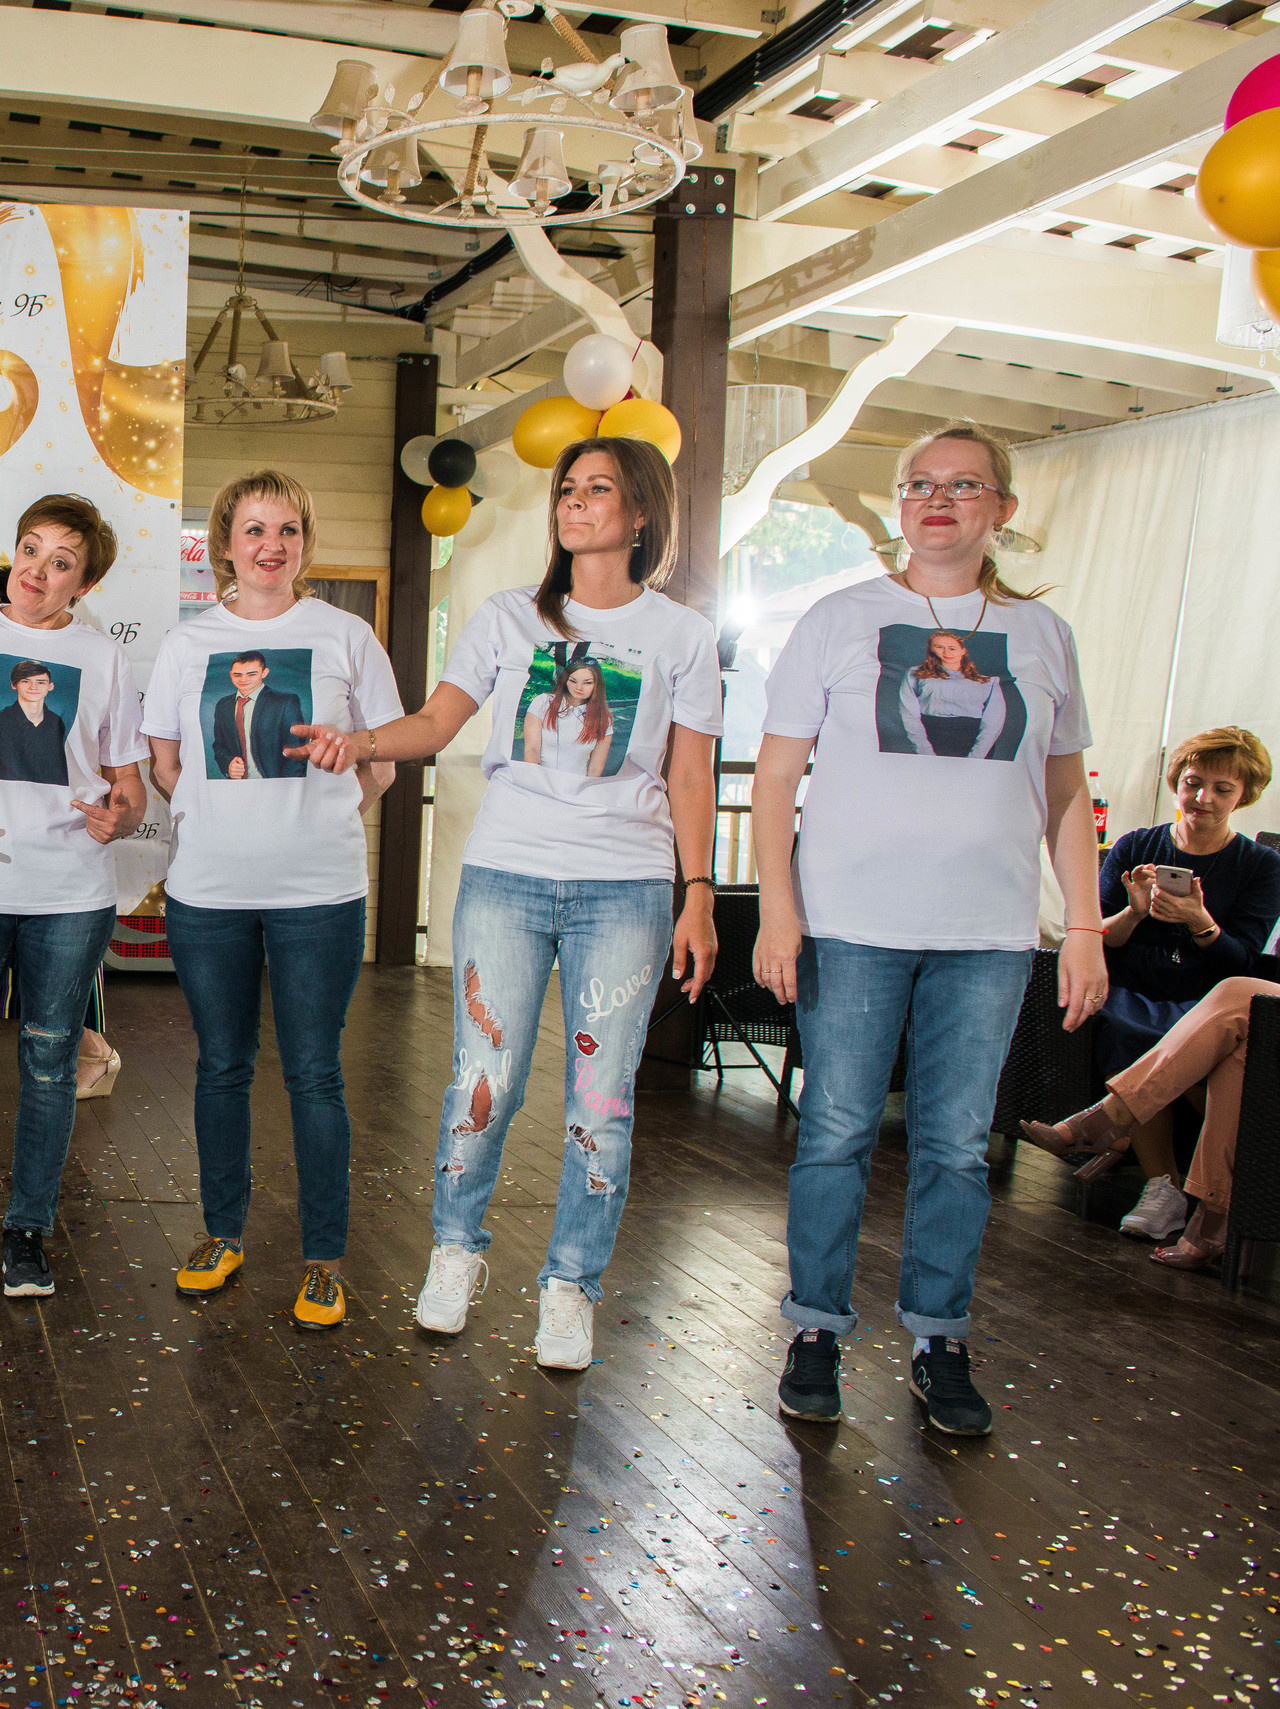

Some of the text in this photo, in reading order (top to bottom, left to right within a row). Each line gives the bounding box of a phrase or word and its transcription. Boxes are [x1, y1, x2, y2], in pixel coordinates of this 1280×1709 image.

[10, 293, 47, 317] 9Б
[110, 621, 141, 644] 9Б
[133, 822, 160, 839] 9Б
[579, 964, 654, 1022] Love
[453, 1047, 514, 1097] Girl
[573, 1057, 630, 1118] Paris
